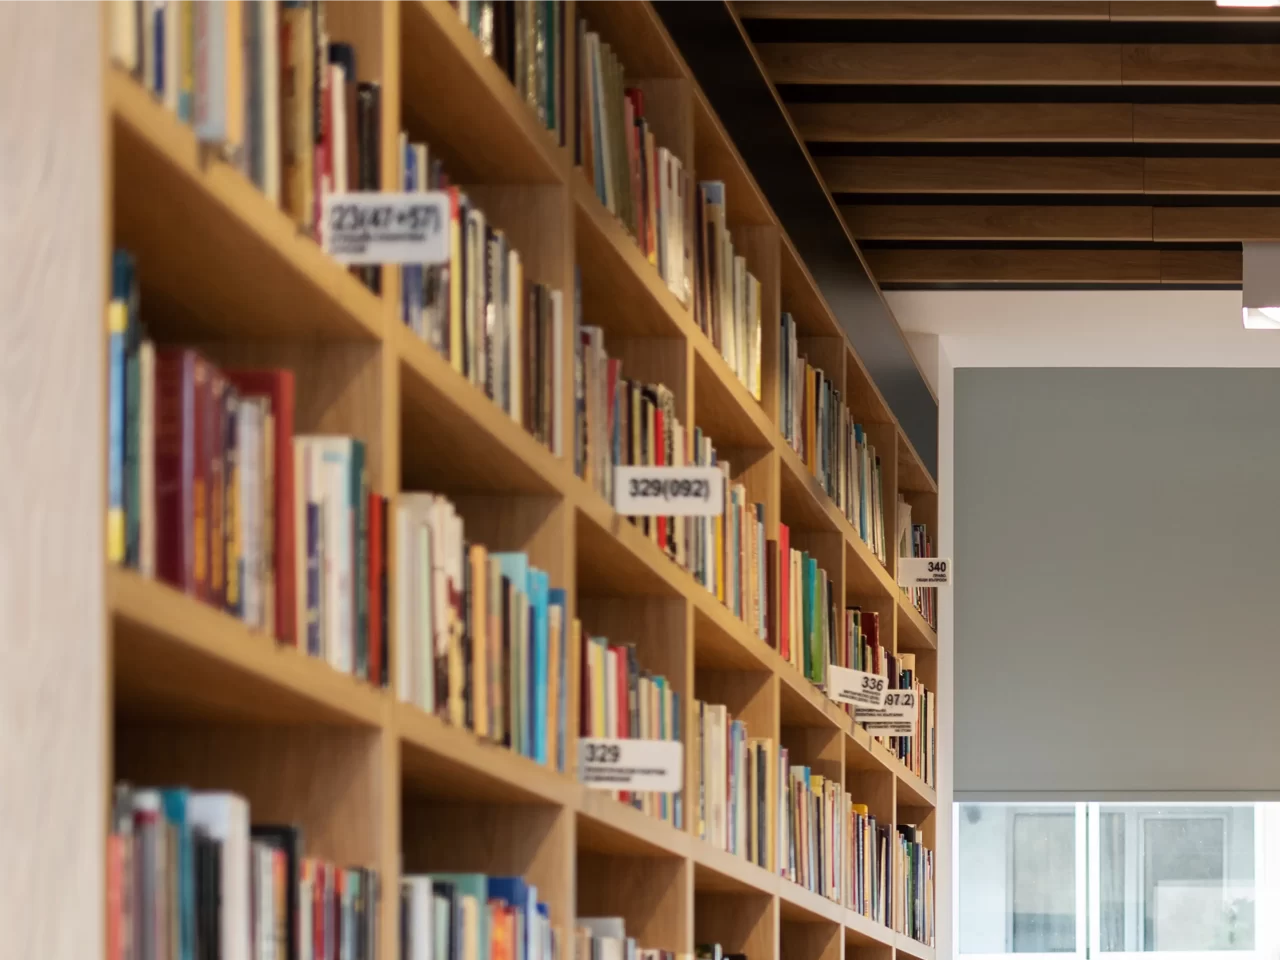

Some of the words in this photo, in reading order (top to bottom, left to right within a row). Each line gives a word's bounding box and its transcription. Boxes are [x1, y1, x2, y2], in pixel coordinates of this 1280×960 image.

[629, 478, 710, 502] 329(092)
[928, 561, 947, 572] 340
[861, 676, 884, 692] 336
[585, 744, 620, 763] 329
